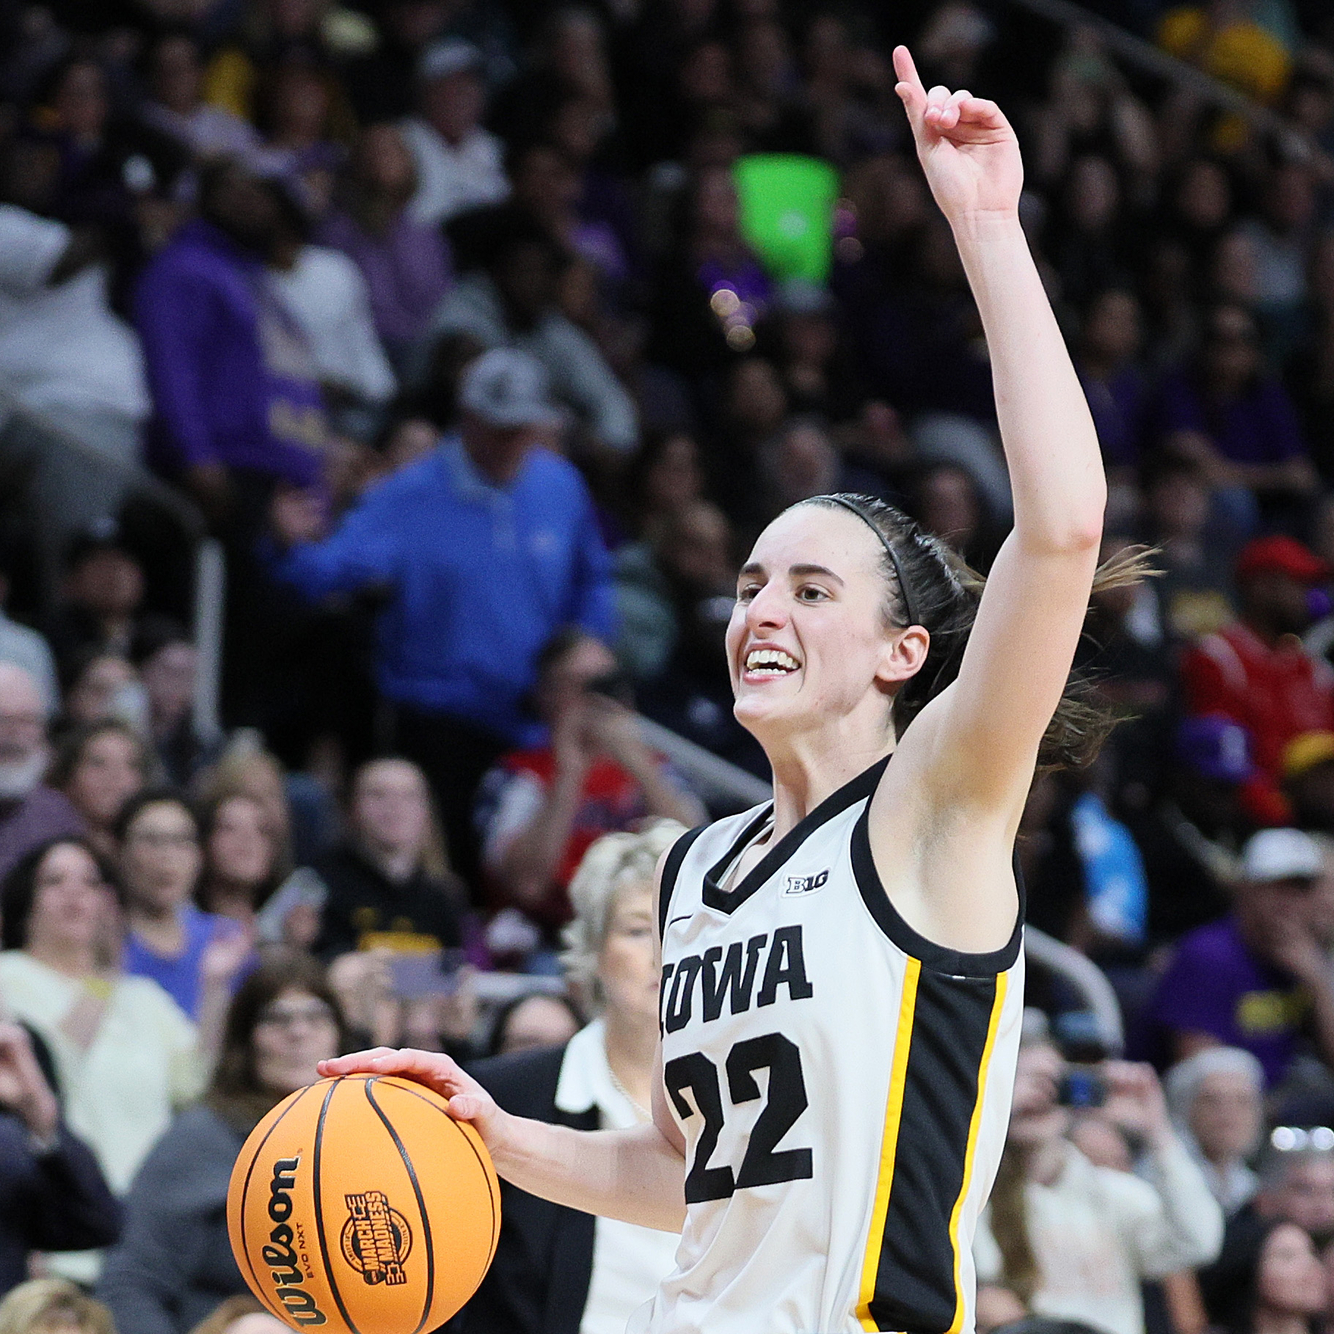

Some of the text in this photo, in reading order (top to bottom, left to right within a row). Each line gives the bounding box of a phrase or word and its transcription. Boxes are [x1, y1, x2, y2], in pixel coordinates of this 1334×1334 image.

[659, 924, 813, 1041] IOWA
[664, 1032, 813, 1205] 22
[262, 1156, 328, 1327] Wilson
[296, 1222, 314, 1278] EVO NXT
[355, 1220, 380, 1270] MARCH
[365, 1191, 394, 1261] MADNESS
